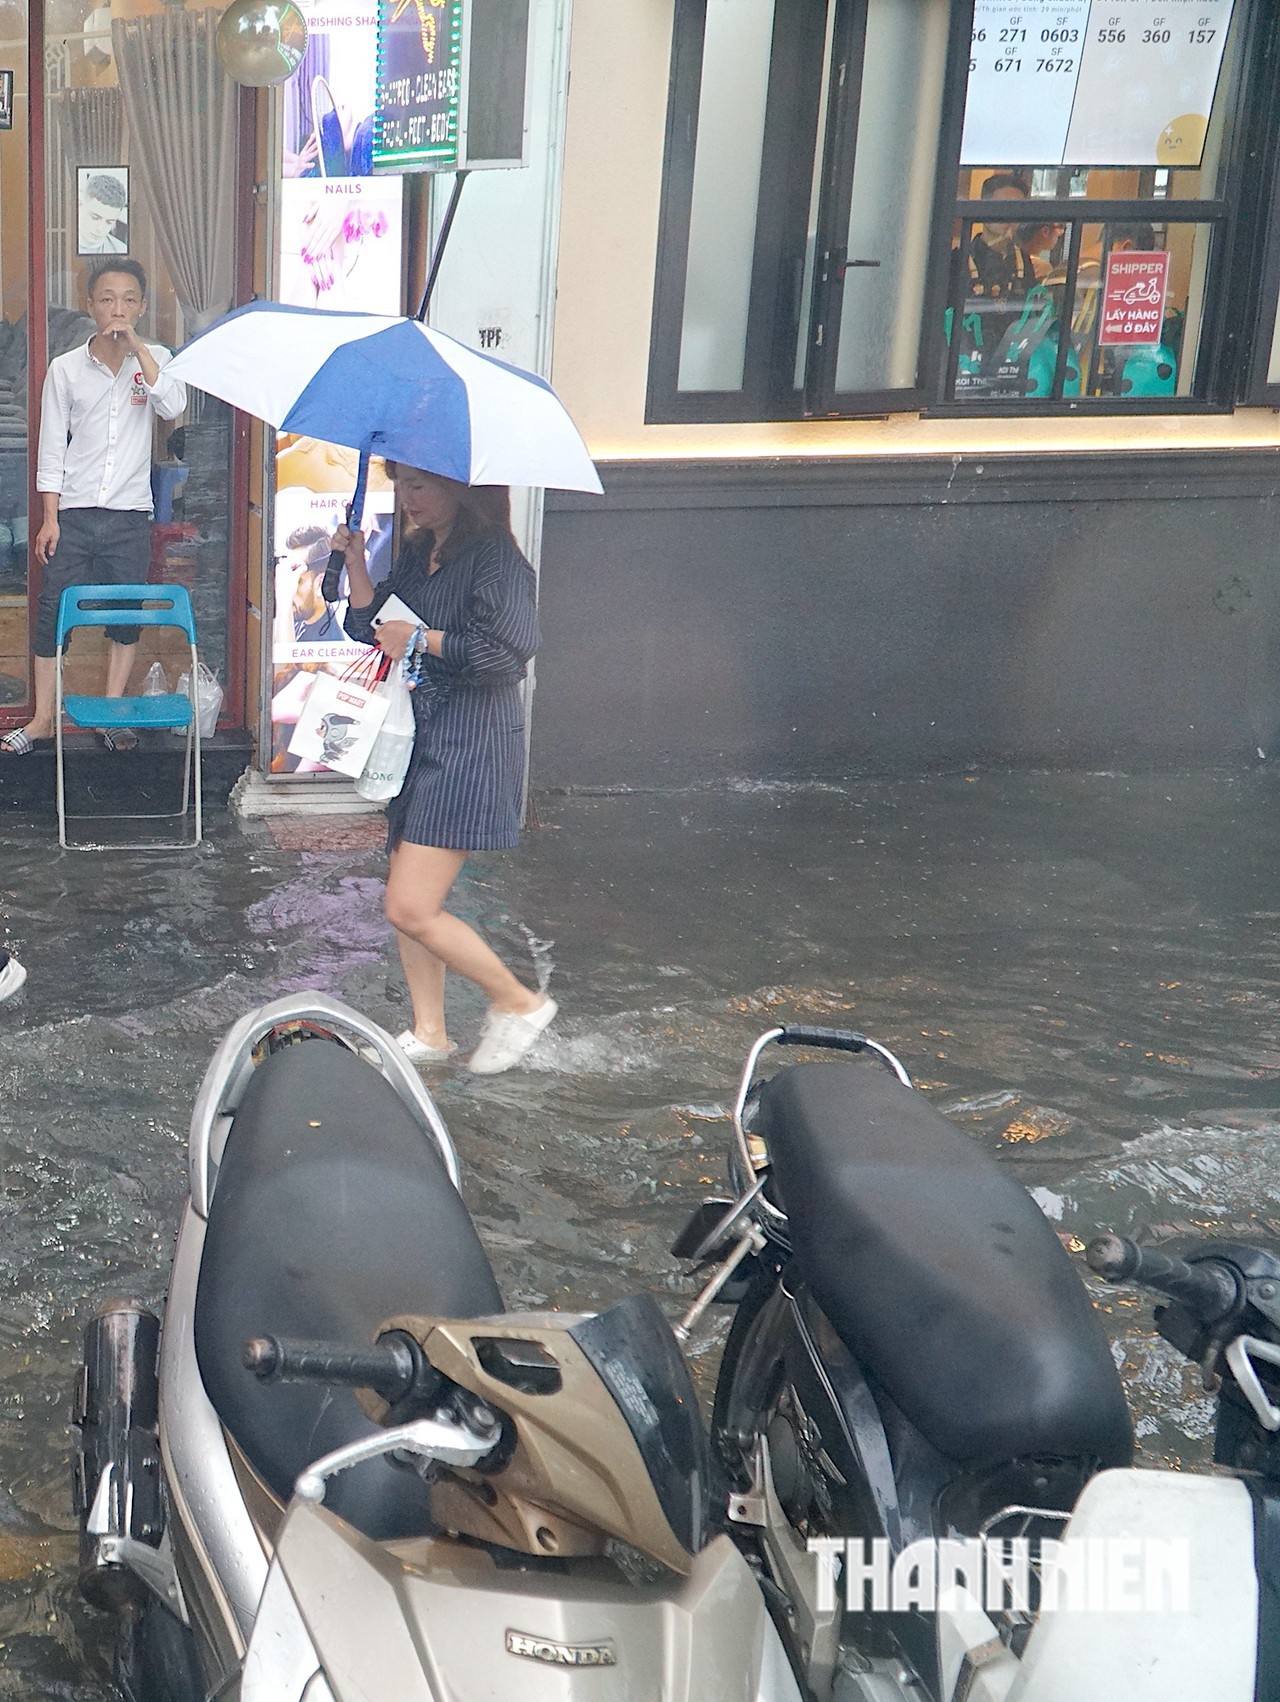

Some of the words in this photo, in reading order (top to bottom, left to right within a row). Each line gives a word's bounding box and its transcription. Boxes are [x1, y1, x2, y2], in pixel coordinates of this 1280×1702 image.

[307, 16, 352, 27] RISHING
[1009, 16, 1023, 25] GF
[1056, 16, 1069, 26] SF
[1108, 17, 1121, 27] GF
[1153, 17, 1166, 27] GF
[1198, 17, 1211, 27] GF
[999, 28, 1027, 42] 271
[1040, 29, 1079, 43] 0603
[1097, 29, 1126, 43] 556
[1141, 29, 1171, 44] 360
[1188, 30, 1216, 44] 157
[1004, 46, 1018, 56] GF
[1051, 47, 1064, 56] SF
[994, 58, 1022, 72] 671
[1035, 59, 1074, 73] 7672
[325, 183, 362, 194] NAILS
[1111, 263, 1163, 275] SHIPPER
[1106, 307, 1127, 321] LẤY
[1127, 308, 1159, 320] HÀNG
[1133, 321, 1157, 333] ĐÂY
[310, 499, 338, 508] HAIR
[292, 648, 314, 658] EAR
[317, 647, 373, 658] CLEANING
[509, 1636, 617, 1666] HONDA
